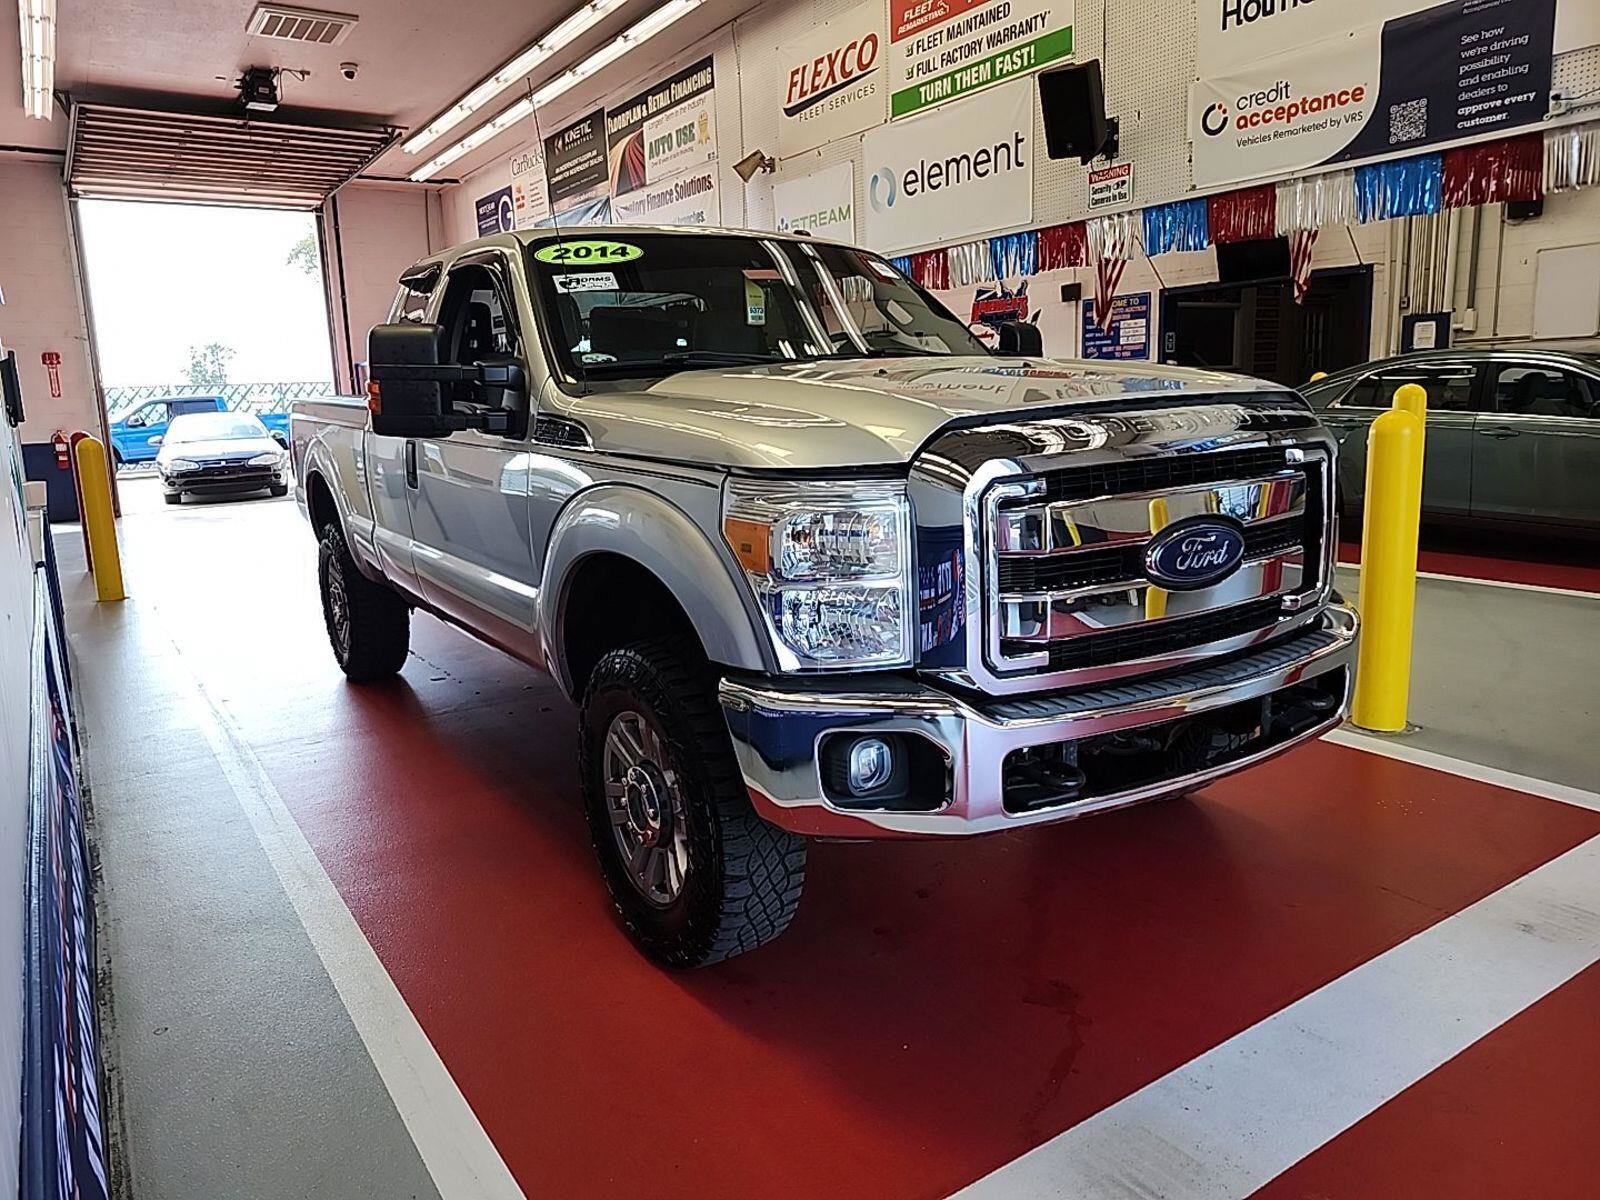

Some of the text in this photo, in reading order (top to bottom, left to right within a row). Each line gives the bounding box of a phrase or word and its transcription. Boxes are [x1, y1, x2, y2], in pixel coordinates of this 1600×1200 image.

[904, 0, 933, 22] FLEET
[916, 2, 1011, 55] FLEET MAINTAINED
[1461, 26, 1505, 45] See how
[916, 56, 938, 78] FULL
[940, 38, 985, 68] FACTORY
[1460, 34, 1530, 58] we're driving
[786, 33, 879, 105] FLEXCO
[919, 44, 1035, 104] TURN THEM FAST!
[1458, 63, 1530, 87] and enabling
[1459, 53, 1511, 75] possibility
[607, 104, 642, 135] FLOORPLAN
[647, 89, 671, 114] RETAIL
[670, 66, 712, 103] FINANCING
[799, 83, 876, 122] FLEET SERVICES
[1236, 81, 1291, 111] credit
[1236, 86, 1365, 130] acceptance
[1457, 91, 1537, 116] approve every
[1458, 83, 1509, 101] dealers to
[1236, 111, 1363, 148] Vehicles Remarketed by VRS
[1457, 112, 1510, 129] customer.
[649, 132, 673, 160] AUTO
[675, 121, 695, 148] USE
[903, 131, 1025, 196] element
[646, 188, 674, 212] Finance
[674, 174, 714, 201] Solutions.
[790, 204, 851, 229] STREAM
[552, 246, 630, 261] 2014
[1130, 298, 1140, 306] TO
[1176, 535, 1229, 570] Ford
